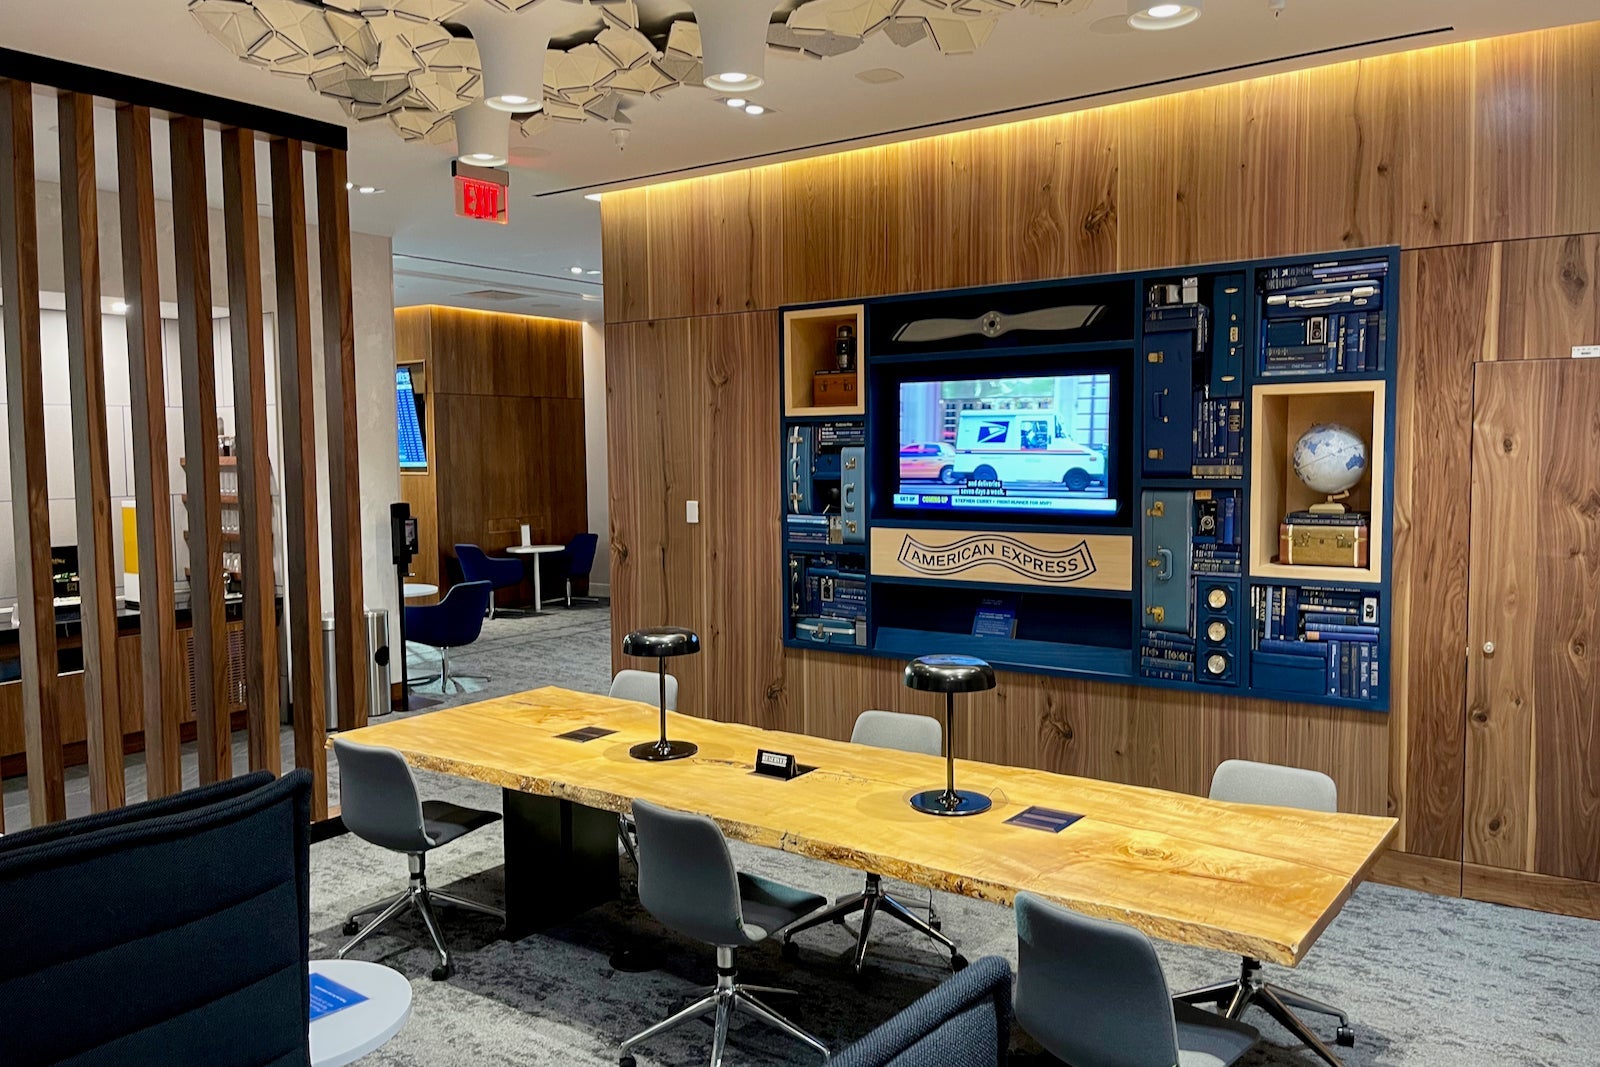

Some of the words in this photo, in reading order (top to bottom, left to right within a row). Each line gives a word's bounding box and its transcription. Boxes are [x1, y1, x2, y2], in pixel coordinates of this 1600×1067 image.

[464, 182, 499, 221] EXIT
[911, 543, 995, 567] AMERICAN
[1001, 545, 1078, 573] EXPRESS
